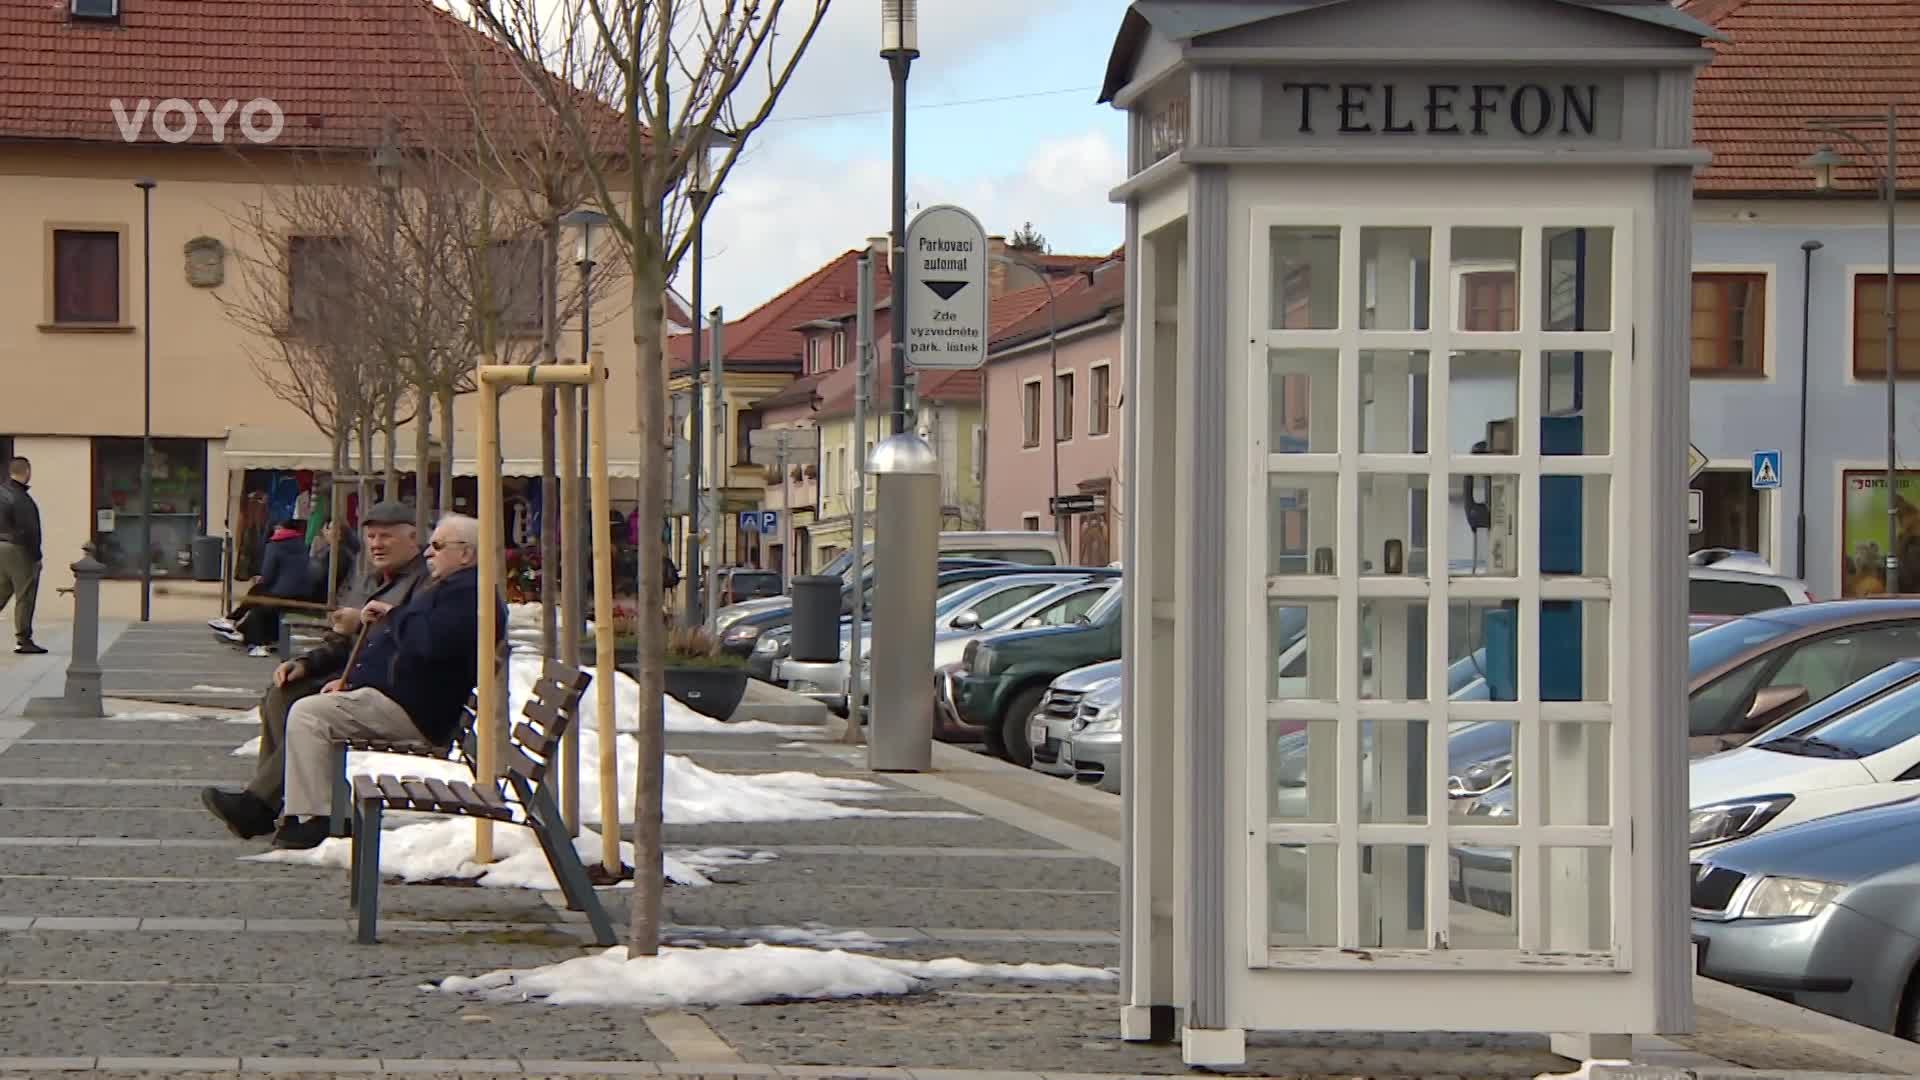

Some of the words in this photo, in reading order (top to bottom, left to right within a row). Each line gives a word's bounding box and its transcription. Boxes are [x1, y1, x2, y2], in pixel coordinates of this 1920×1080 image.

[1282, 83, 1599, 136] TELEFON
[923, 257, 968, 271] automat
[932, 310, 957, 321] Zde
[763, 513, 775, 527] P
